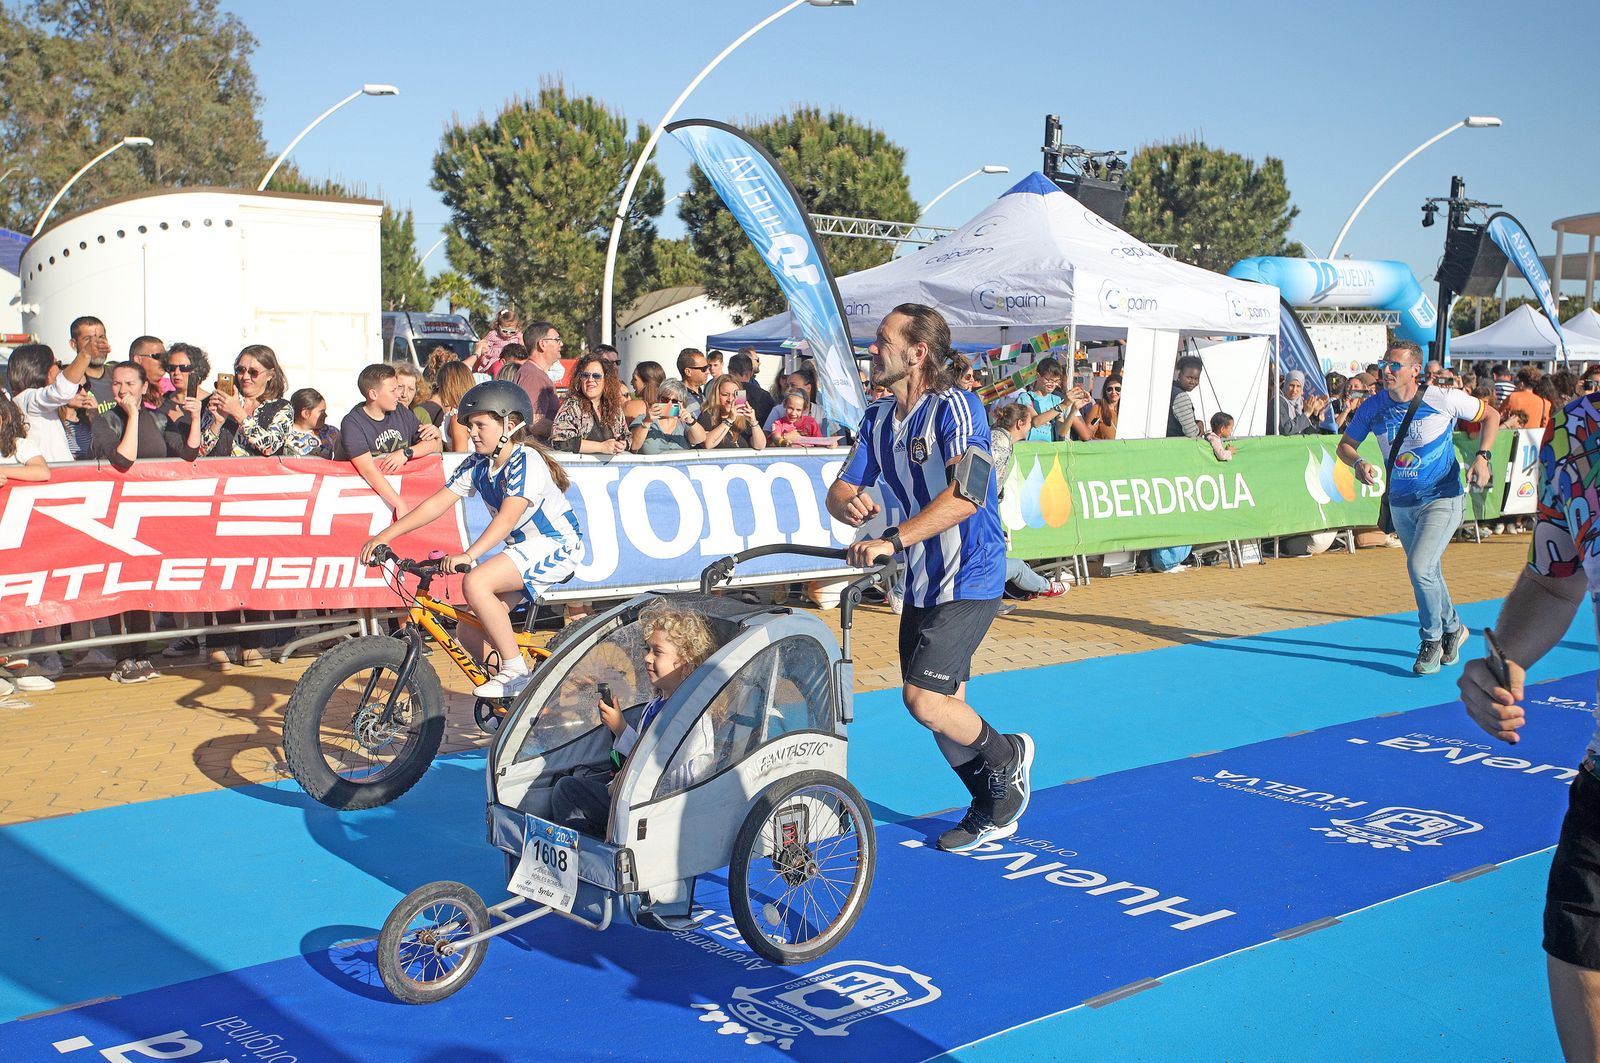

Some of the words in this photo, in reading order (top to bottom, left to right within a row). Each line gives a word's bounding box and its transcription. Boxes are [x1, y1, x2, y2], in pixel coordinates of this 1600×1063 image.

[1339, 268, 1375, 287] HUELVA
[1079, 472, 1256, 520] IBERDROLA
[441, 638, 484, 678] SPITZ
[1405, 732, 1492, 751] original
[1376, 736, 1580, 785] uelva
[1192, 775, 1216, 783] de
[1214, 769, 1368, 808] HUELVA
[1217, 782, 1342, 812] Ayuntamiento
[533, 840, 568, 872] 1608
[1008, 834, 1078, 858] origin
[672, 929, 772, 970] Ayuntamie
[784, 972, 835, 990] CUSTODIA
